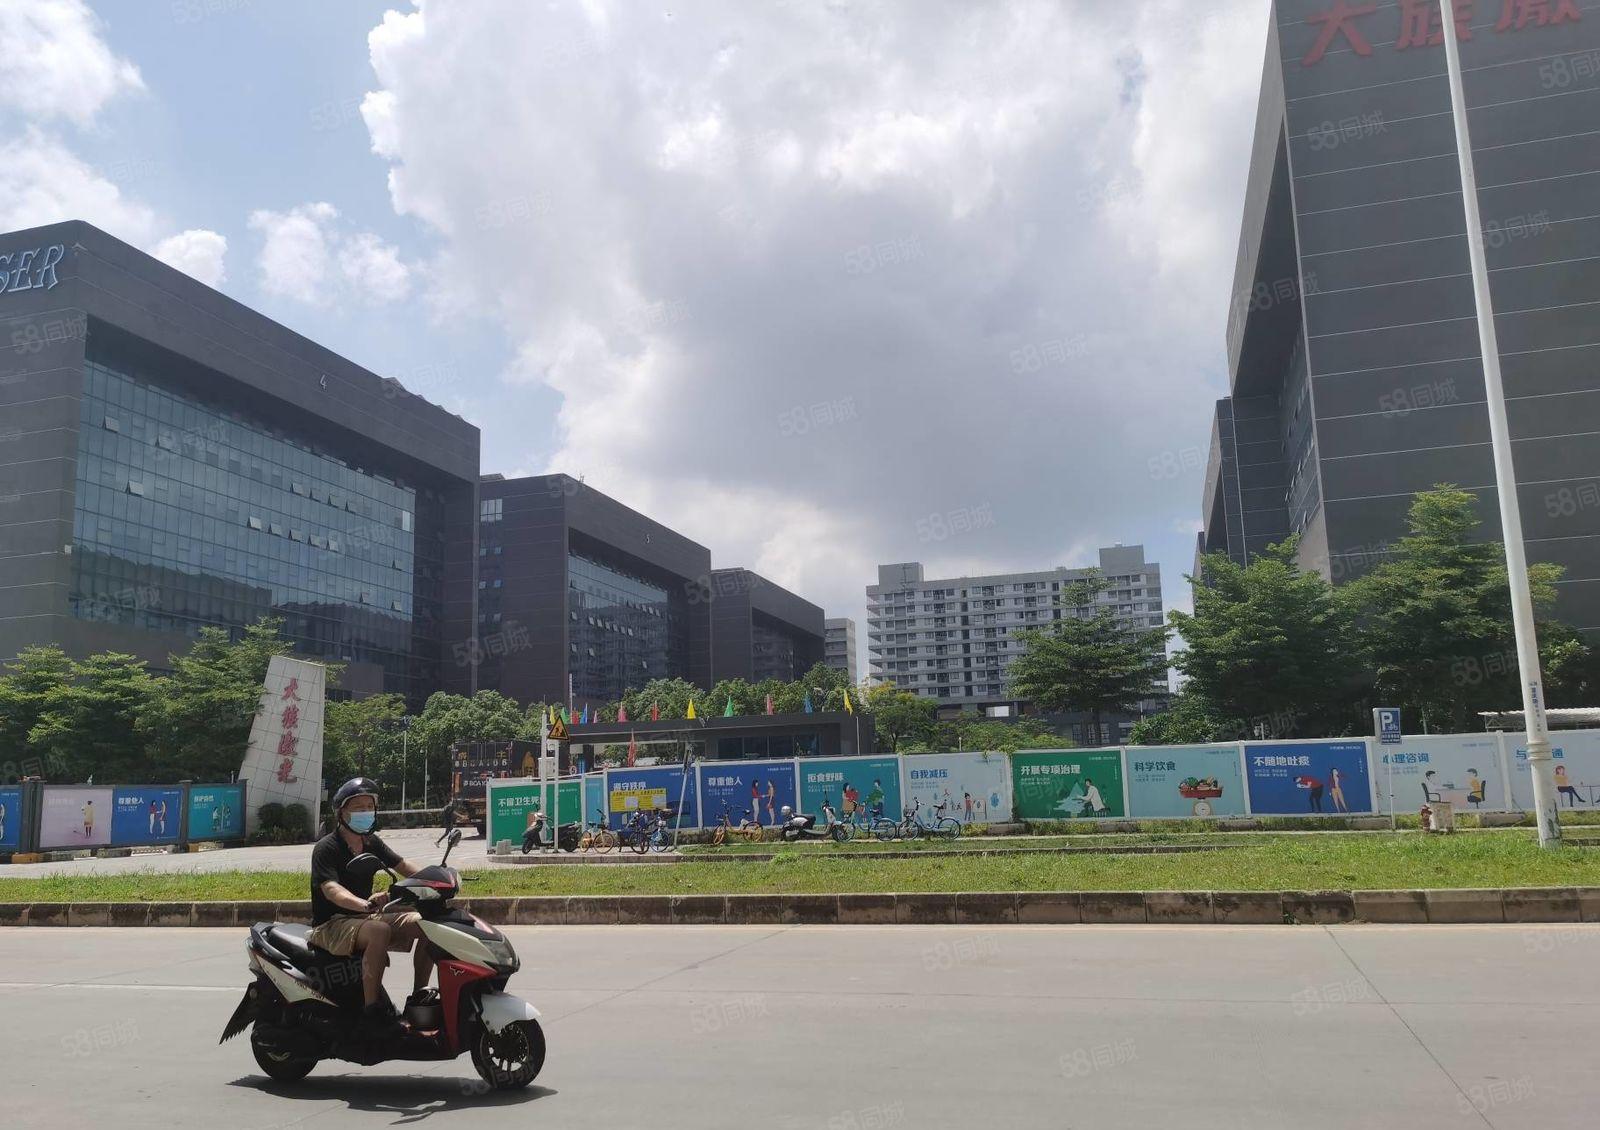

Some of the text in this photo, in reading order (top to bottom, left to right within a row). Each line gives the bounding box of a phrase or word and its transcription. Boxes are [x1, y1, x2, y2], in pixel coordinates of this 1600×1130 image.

[1381, 711, 1393, 731] P
[1134, 761, 1177, 772] 科学饮食
[1254, 756, 1310, 767] 不随地吐痰
[911, 768, 948, 779] 自我减压
[1021, 764, 1081, 776] 开展专项治理
[708, 776, 743, 787] 尊重他人
[498, 796, 541, 807] 不留卫生死
